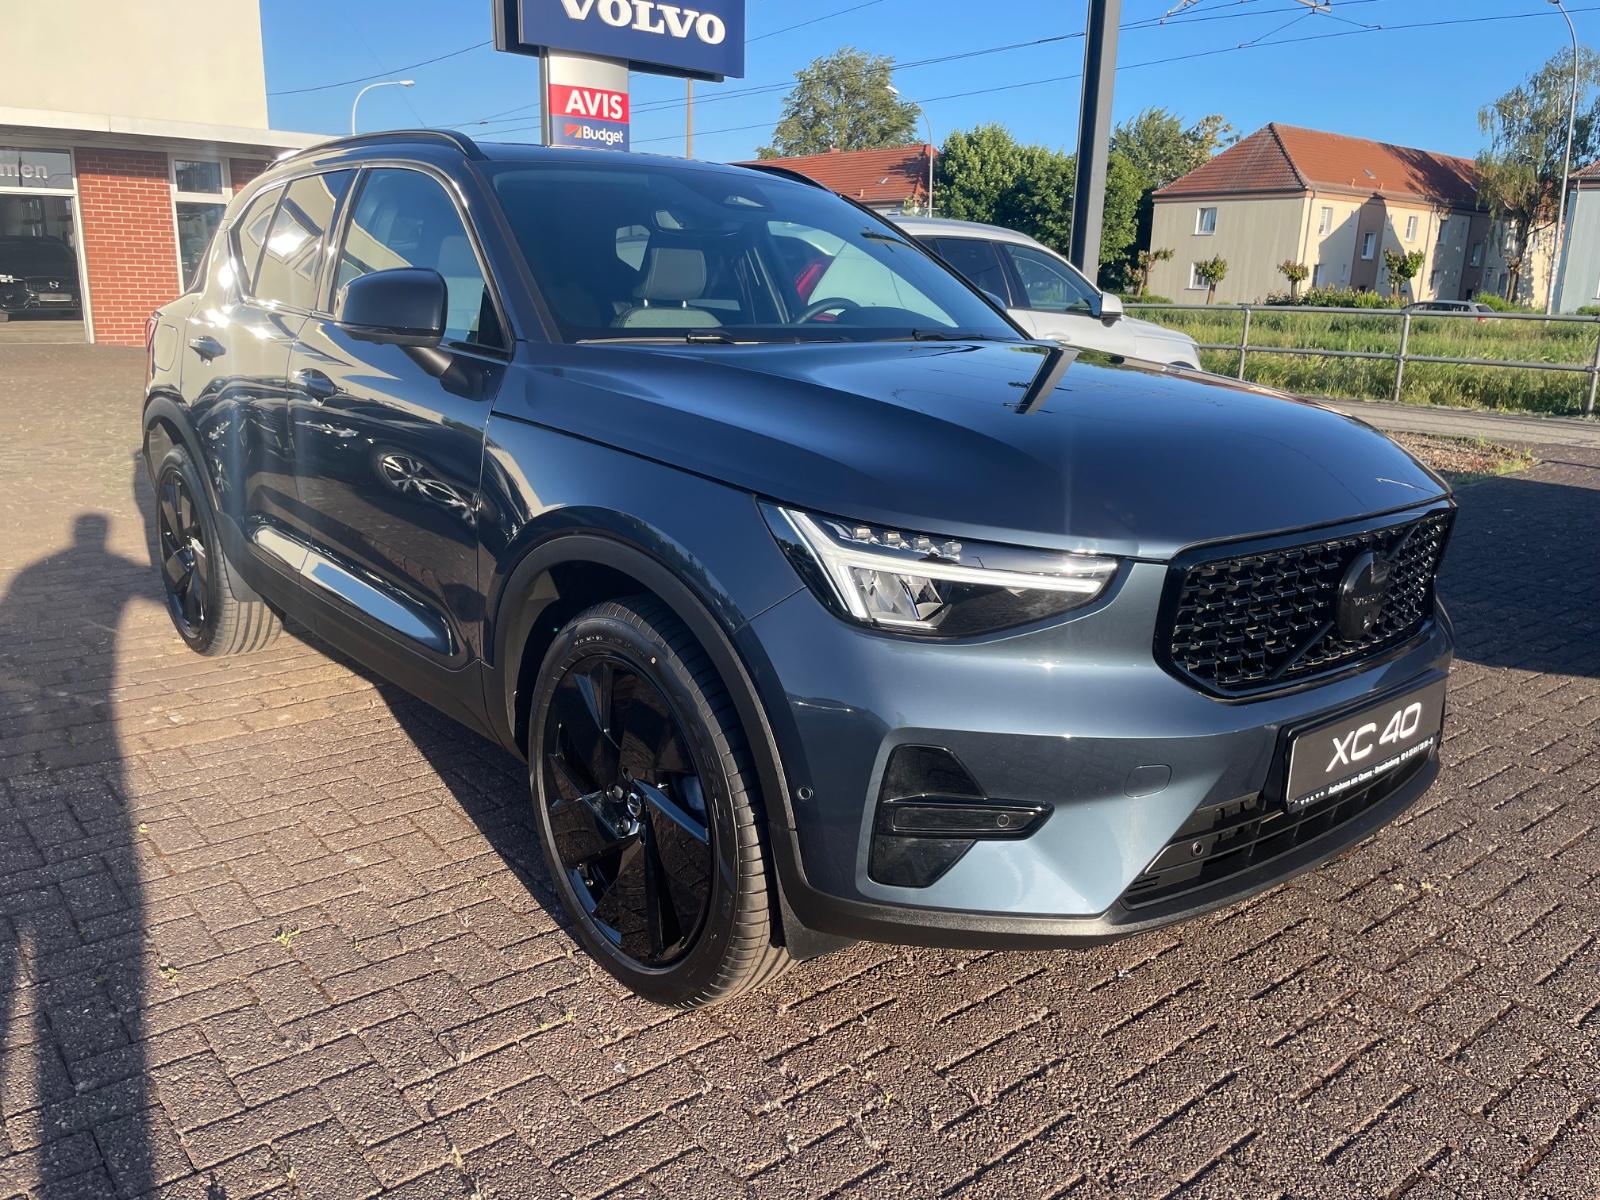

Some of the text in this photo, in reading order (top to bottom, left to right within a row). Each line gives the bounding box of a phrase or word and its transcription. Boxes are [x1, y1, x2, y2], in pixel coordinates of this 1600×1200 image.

[562, 0, 726, 45] VOLVO
[565, 89, 623, 120] AVIS
[583, 125, 624, 145] Budget
[1325, 722, 1377, 773] XC
[1379, 702, 1422, 745] 40
